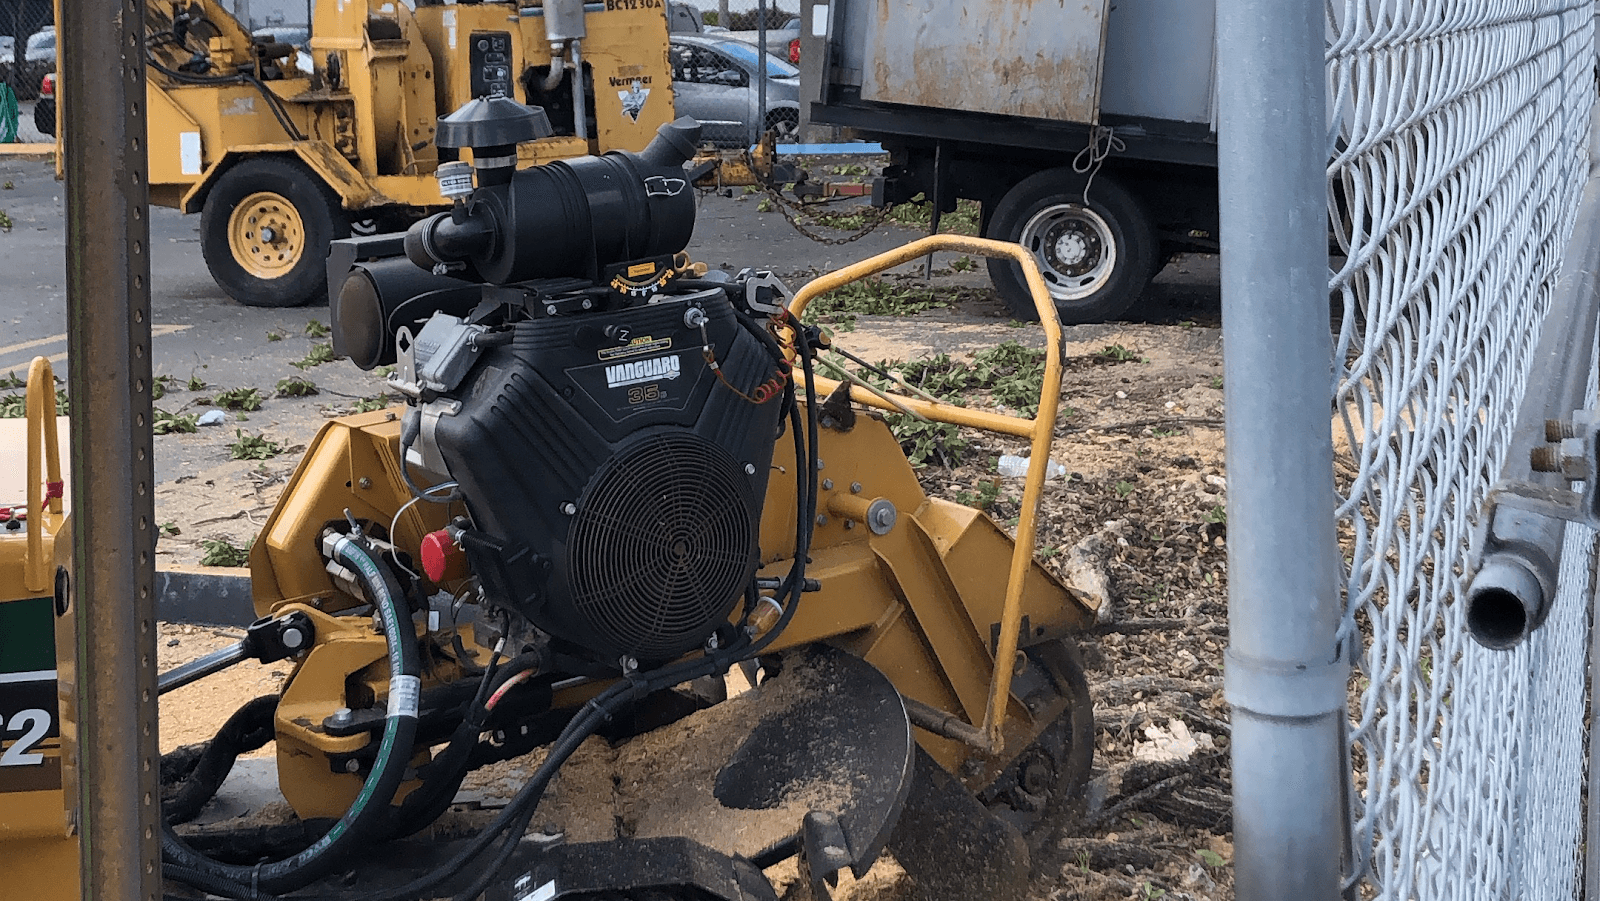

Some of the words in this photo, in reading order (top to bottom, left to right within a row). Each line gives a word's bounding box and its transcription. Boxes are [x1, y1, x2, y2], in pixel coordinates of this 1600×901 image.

[605, 355, 680, 384] VANGUARD
[628, 384, 660, 404] 35
[0, 709, 52, 767] 2
